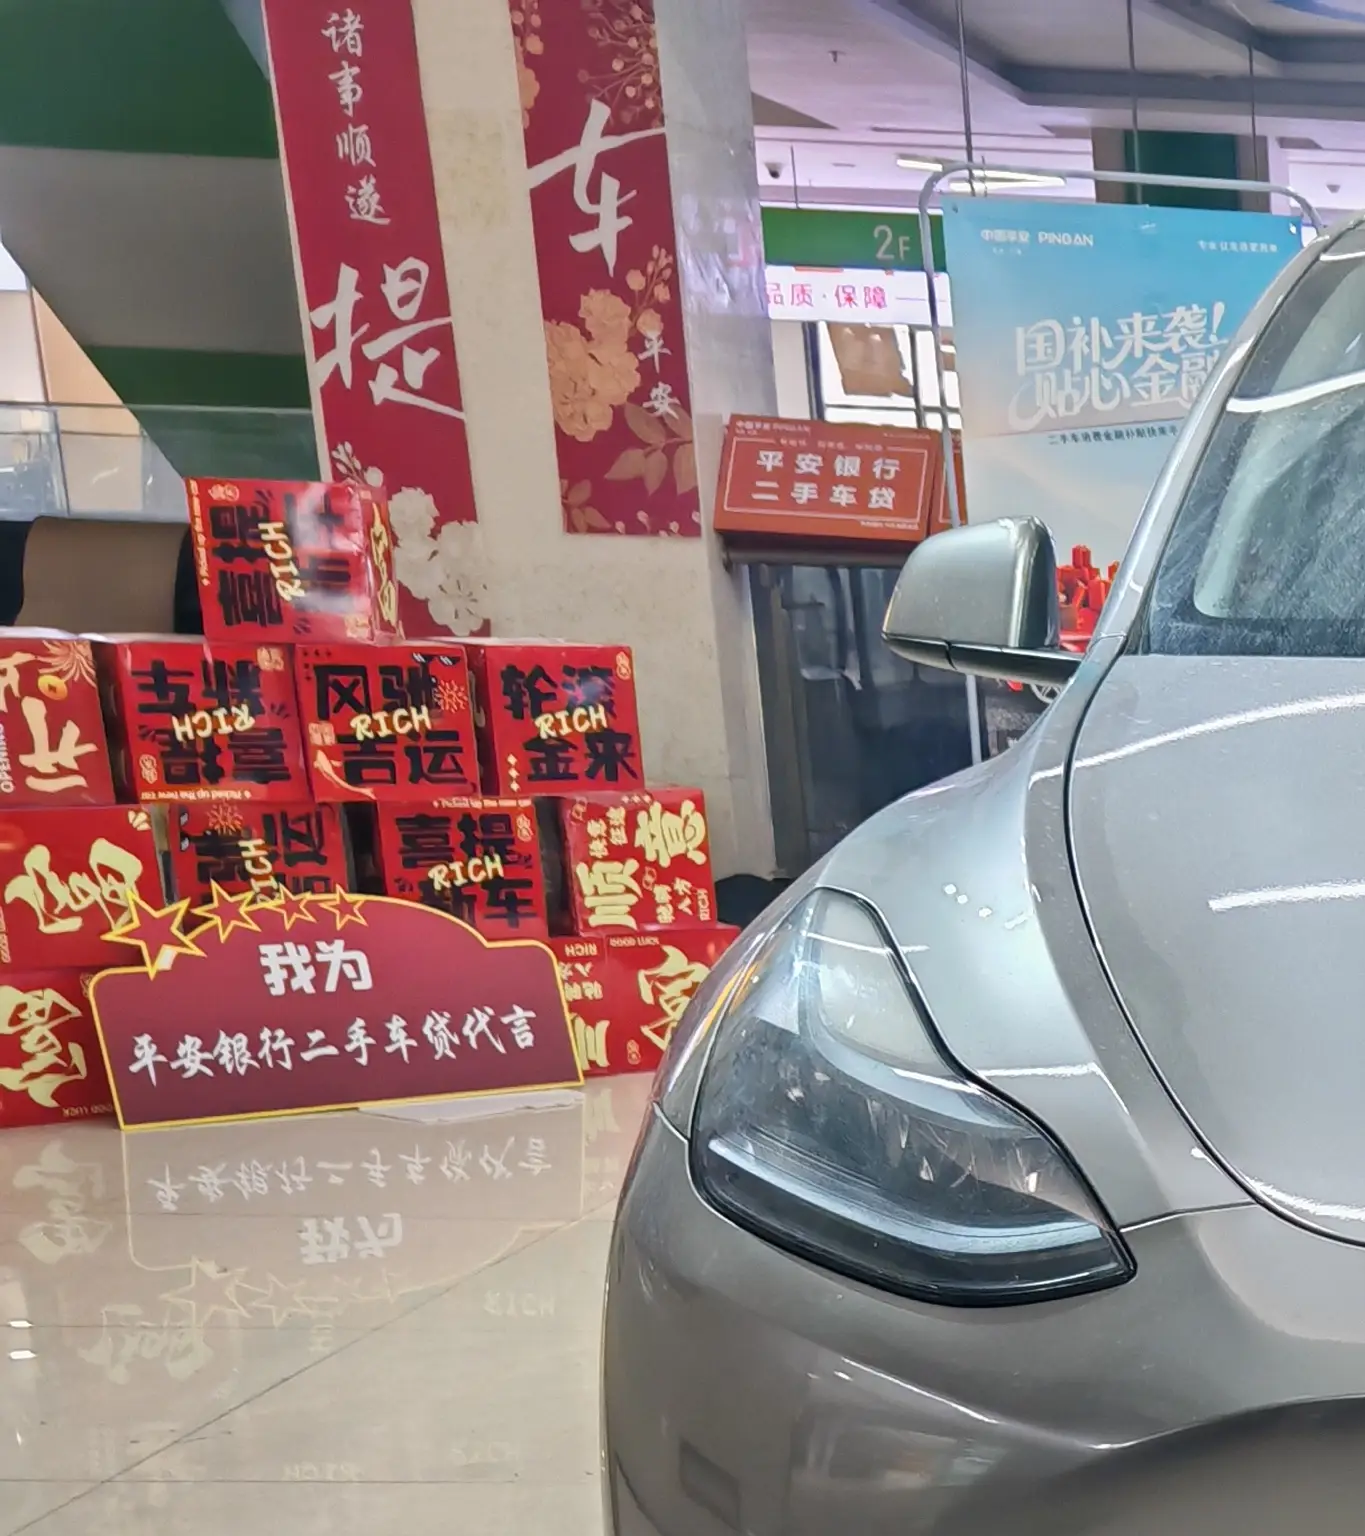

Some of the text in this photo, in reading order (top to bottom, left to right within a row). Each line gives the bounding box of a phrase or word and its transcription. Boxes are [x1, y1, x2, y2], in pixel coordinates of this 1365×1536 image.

[321, 9, 391, 226] 诸事顺遂
[873, 224, 911, 261] 2F
[757, 450, 900, 480] 平安银行
[752, 480, 896, 510] 二手车贷
[258, 521, 305, 602] RICH
[172, 704, 255, 741] RICH
[351, 705, 432, 740] RICH
[535, 704, 608, 739] RICH
[428, 853, 504, 890] RICH
[258, 939, 374, 996] 我为
[128, 1003, 538, 1087] 平安银行二手车贷代言
